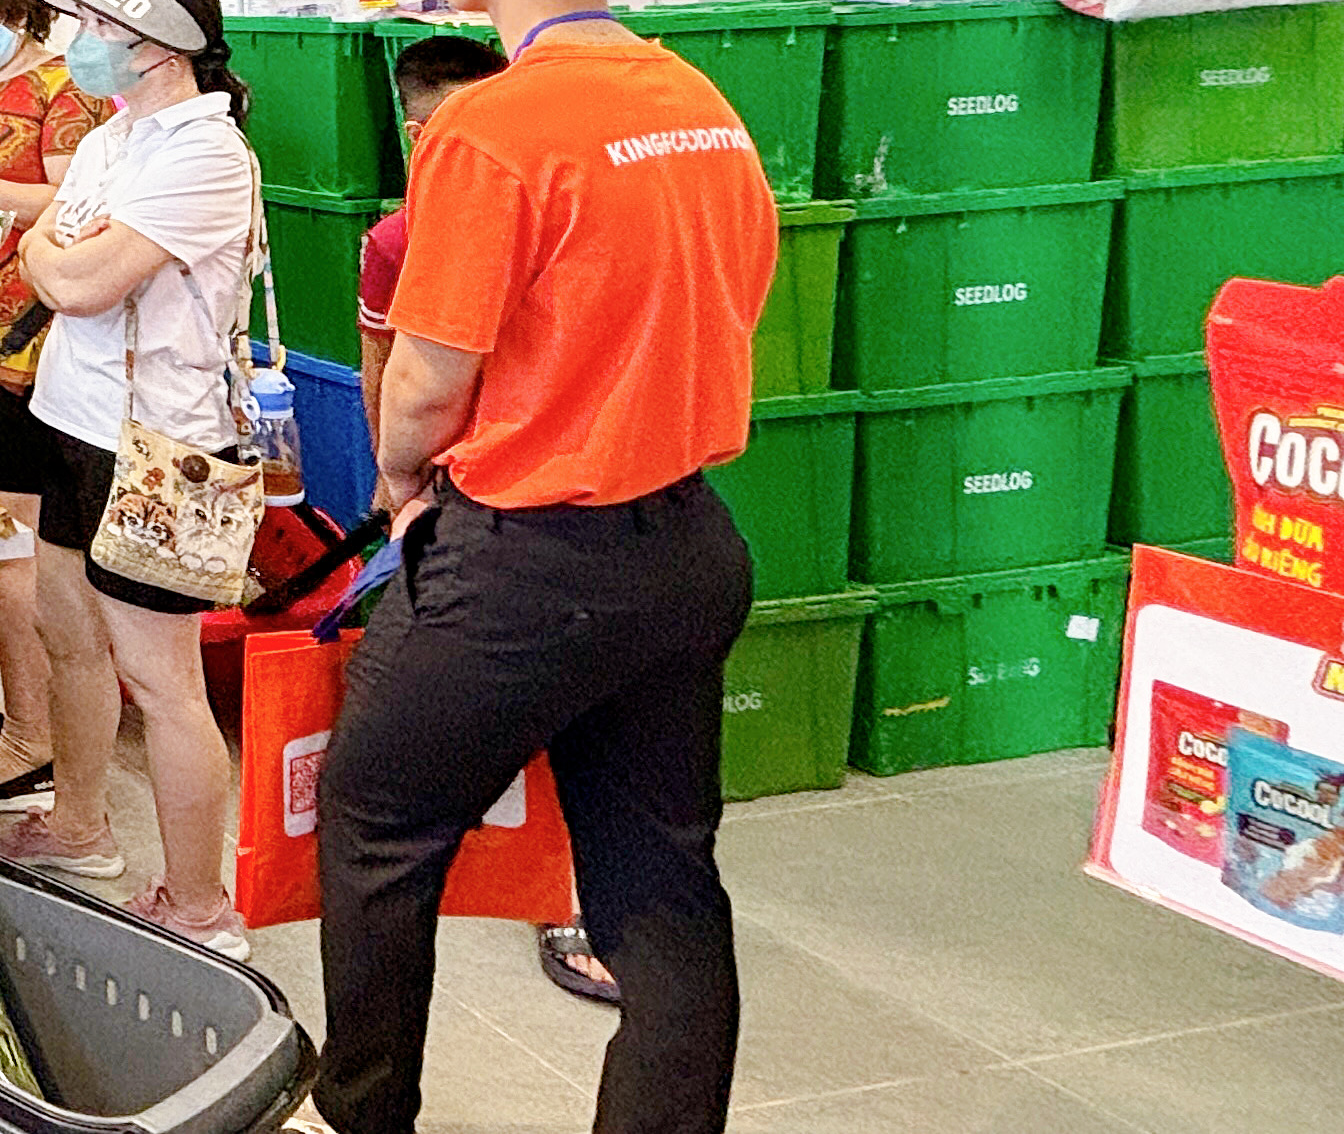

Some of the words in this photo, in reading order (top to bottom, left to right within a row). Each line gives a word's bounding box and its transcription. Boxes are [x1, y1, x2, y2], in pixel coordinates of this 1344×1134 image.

[947, 94, 1019, 116] SEEDLOG
[604, 128, 753, 167] KINGFOODma
[954, 281, 1028, 307] SEEDLOG
[963, 470, 1034, 495] SEEDLOG
